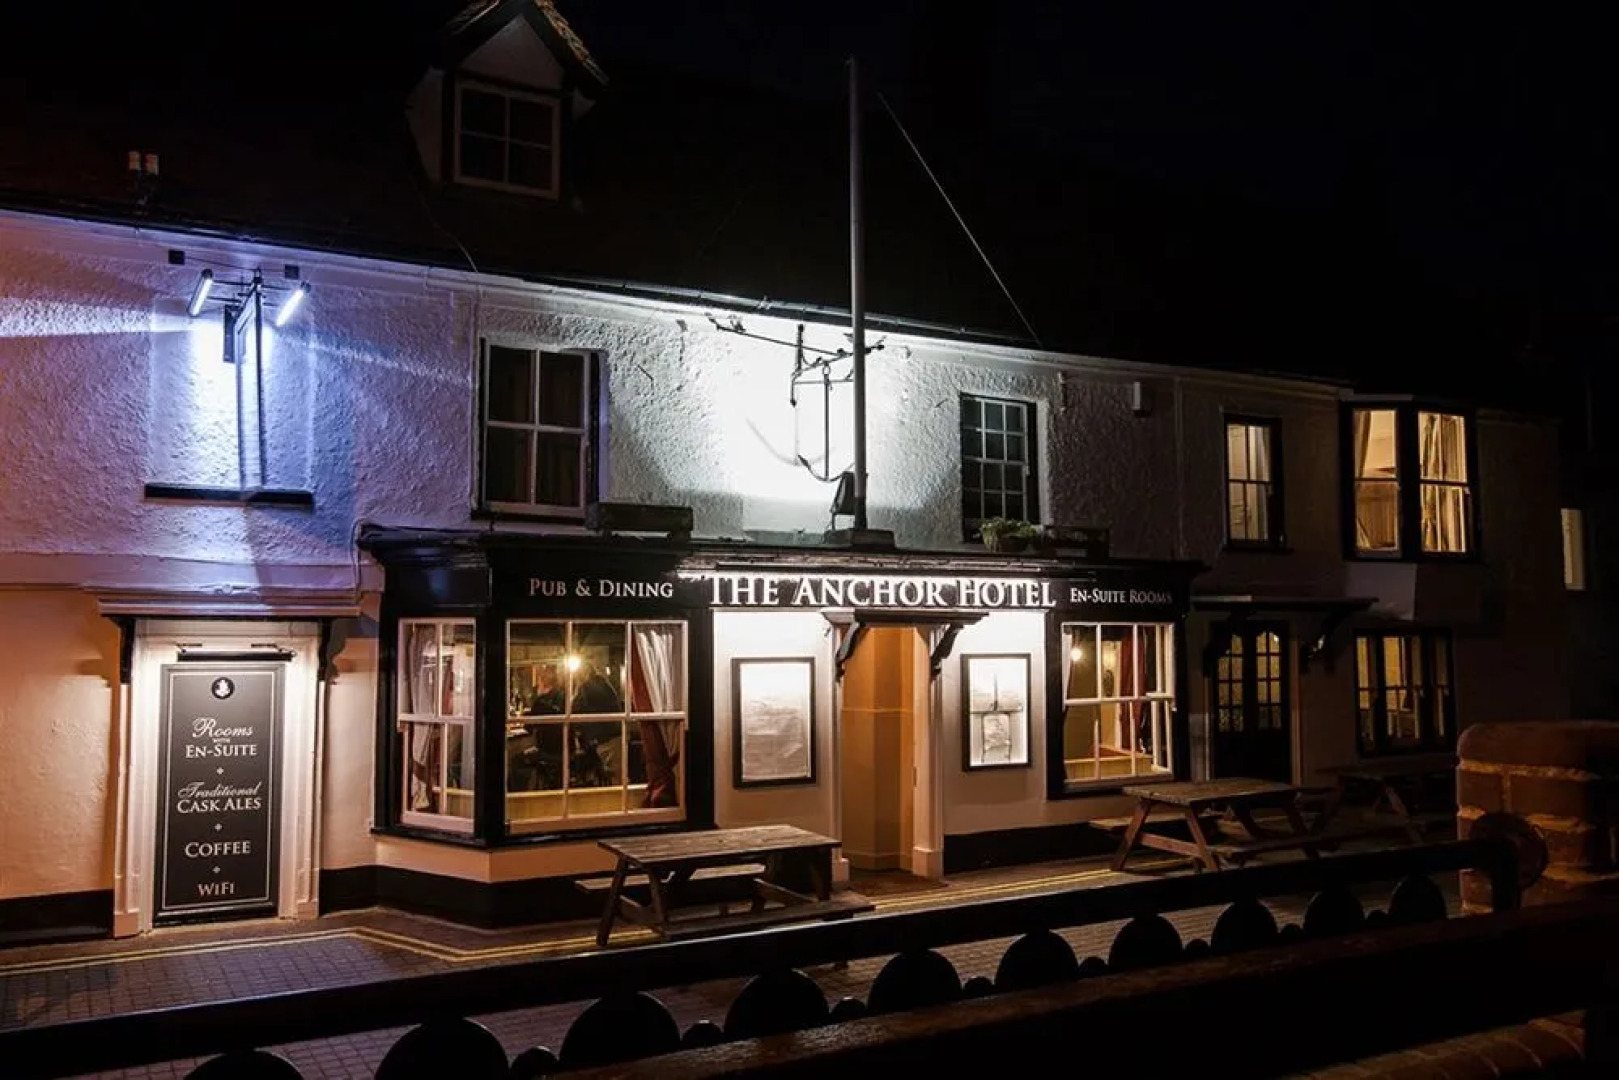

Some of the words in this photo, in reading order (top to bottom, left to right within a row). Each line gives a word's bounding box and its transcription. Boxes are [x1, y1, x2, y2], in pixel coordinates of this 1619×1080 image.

[575, 579, 591, 597] &
[599, 578, 674, 598] DINING
[707, 574, 779, 606] THE
[791, 575, 949, 607] ANCHOR
[957, 577, 1057, 608] HOTEL
[1069, 587, 1127, 604] EN-SUITE
[1129, 588, 1173, 605] ROOMS
[192, 717, 253, 738] Rooms
[185, 743, 257, 759] EN-SUITE
[178, 781, 262, 798] Traditional
[177, 798, 221, 814] CASK
[223, 797, 262, 811] ALES
[185, 841, 251, 858] COFFEE
